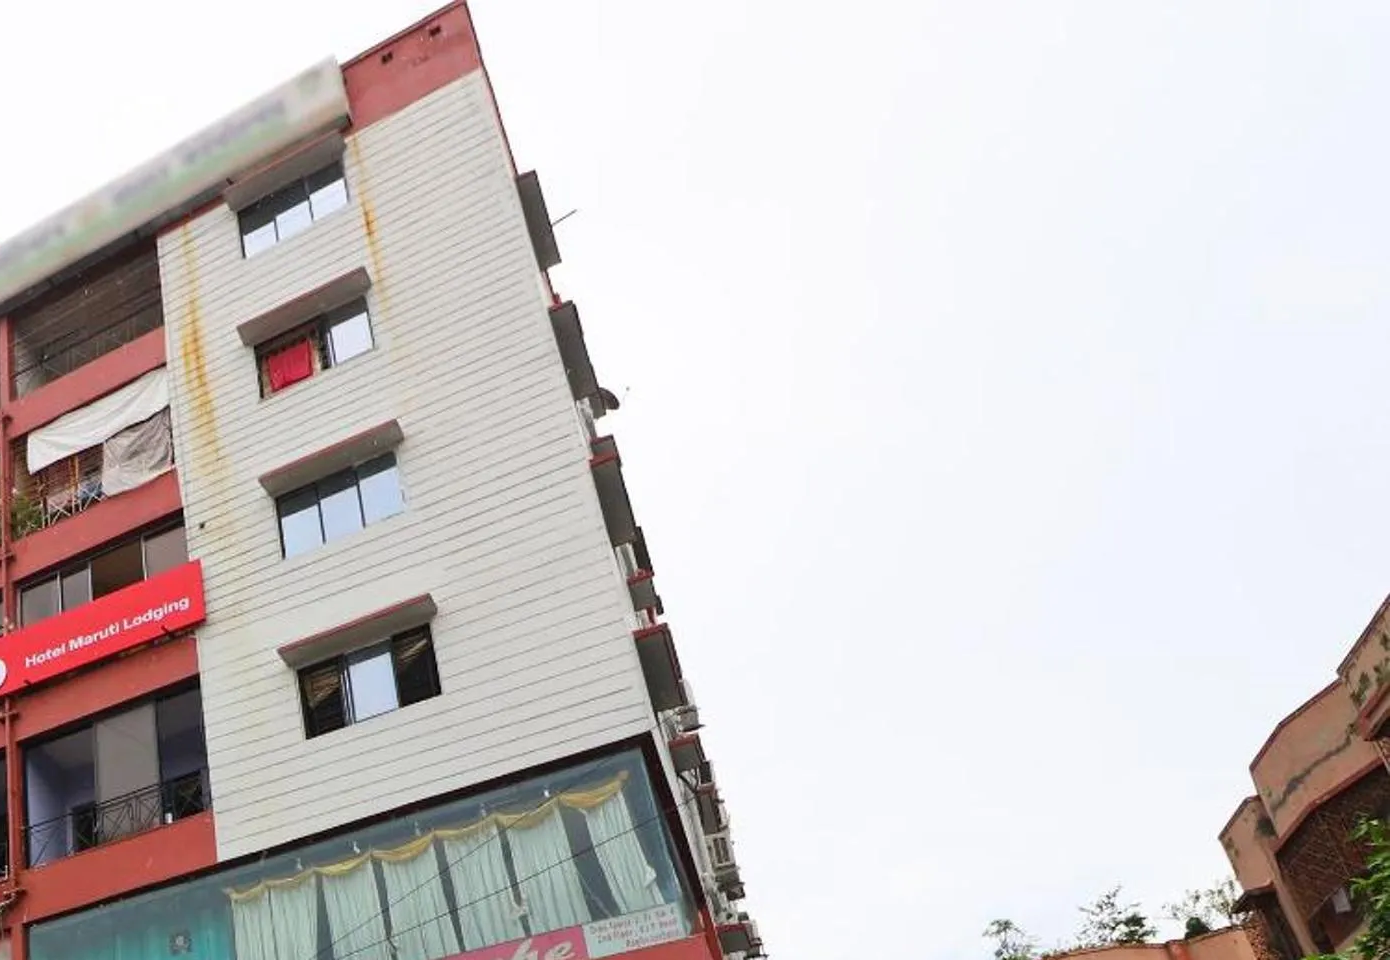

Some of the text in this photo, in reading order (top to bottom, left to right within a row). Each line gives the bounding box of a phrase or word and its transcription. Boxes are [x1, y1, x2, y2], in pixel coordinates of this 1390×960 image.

[25, 595, 190, 668] Hotel Maruti Lodging
